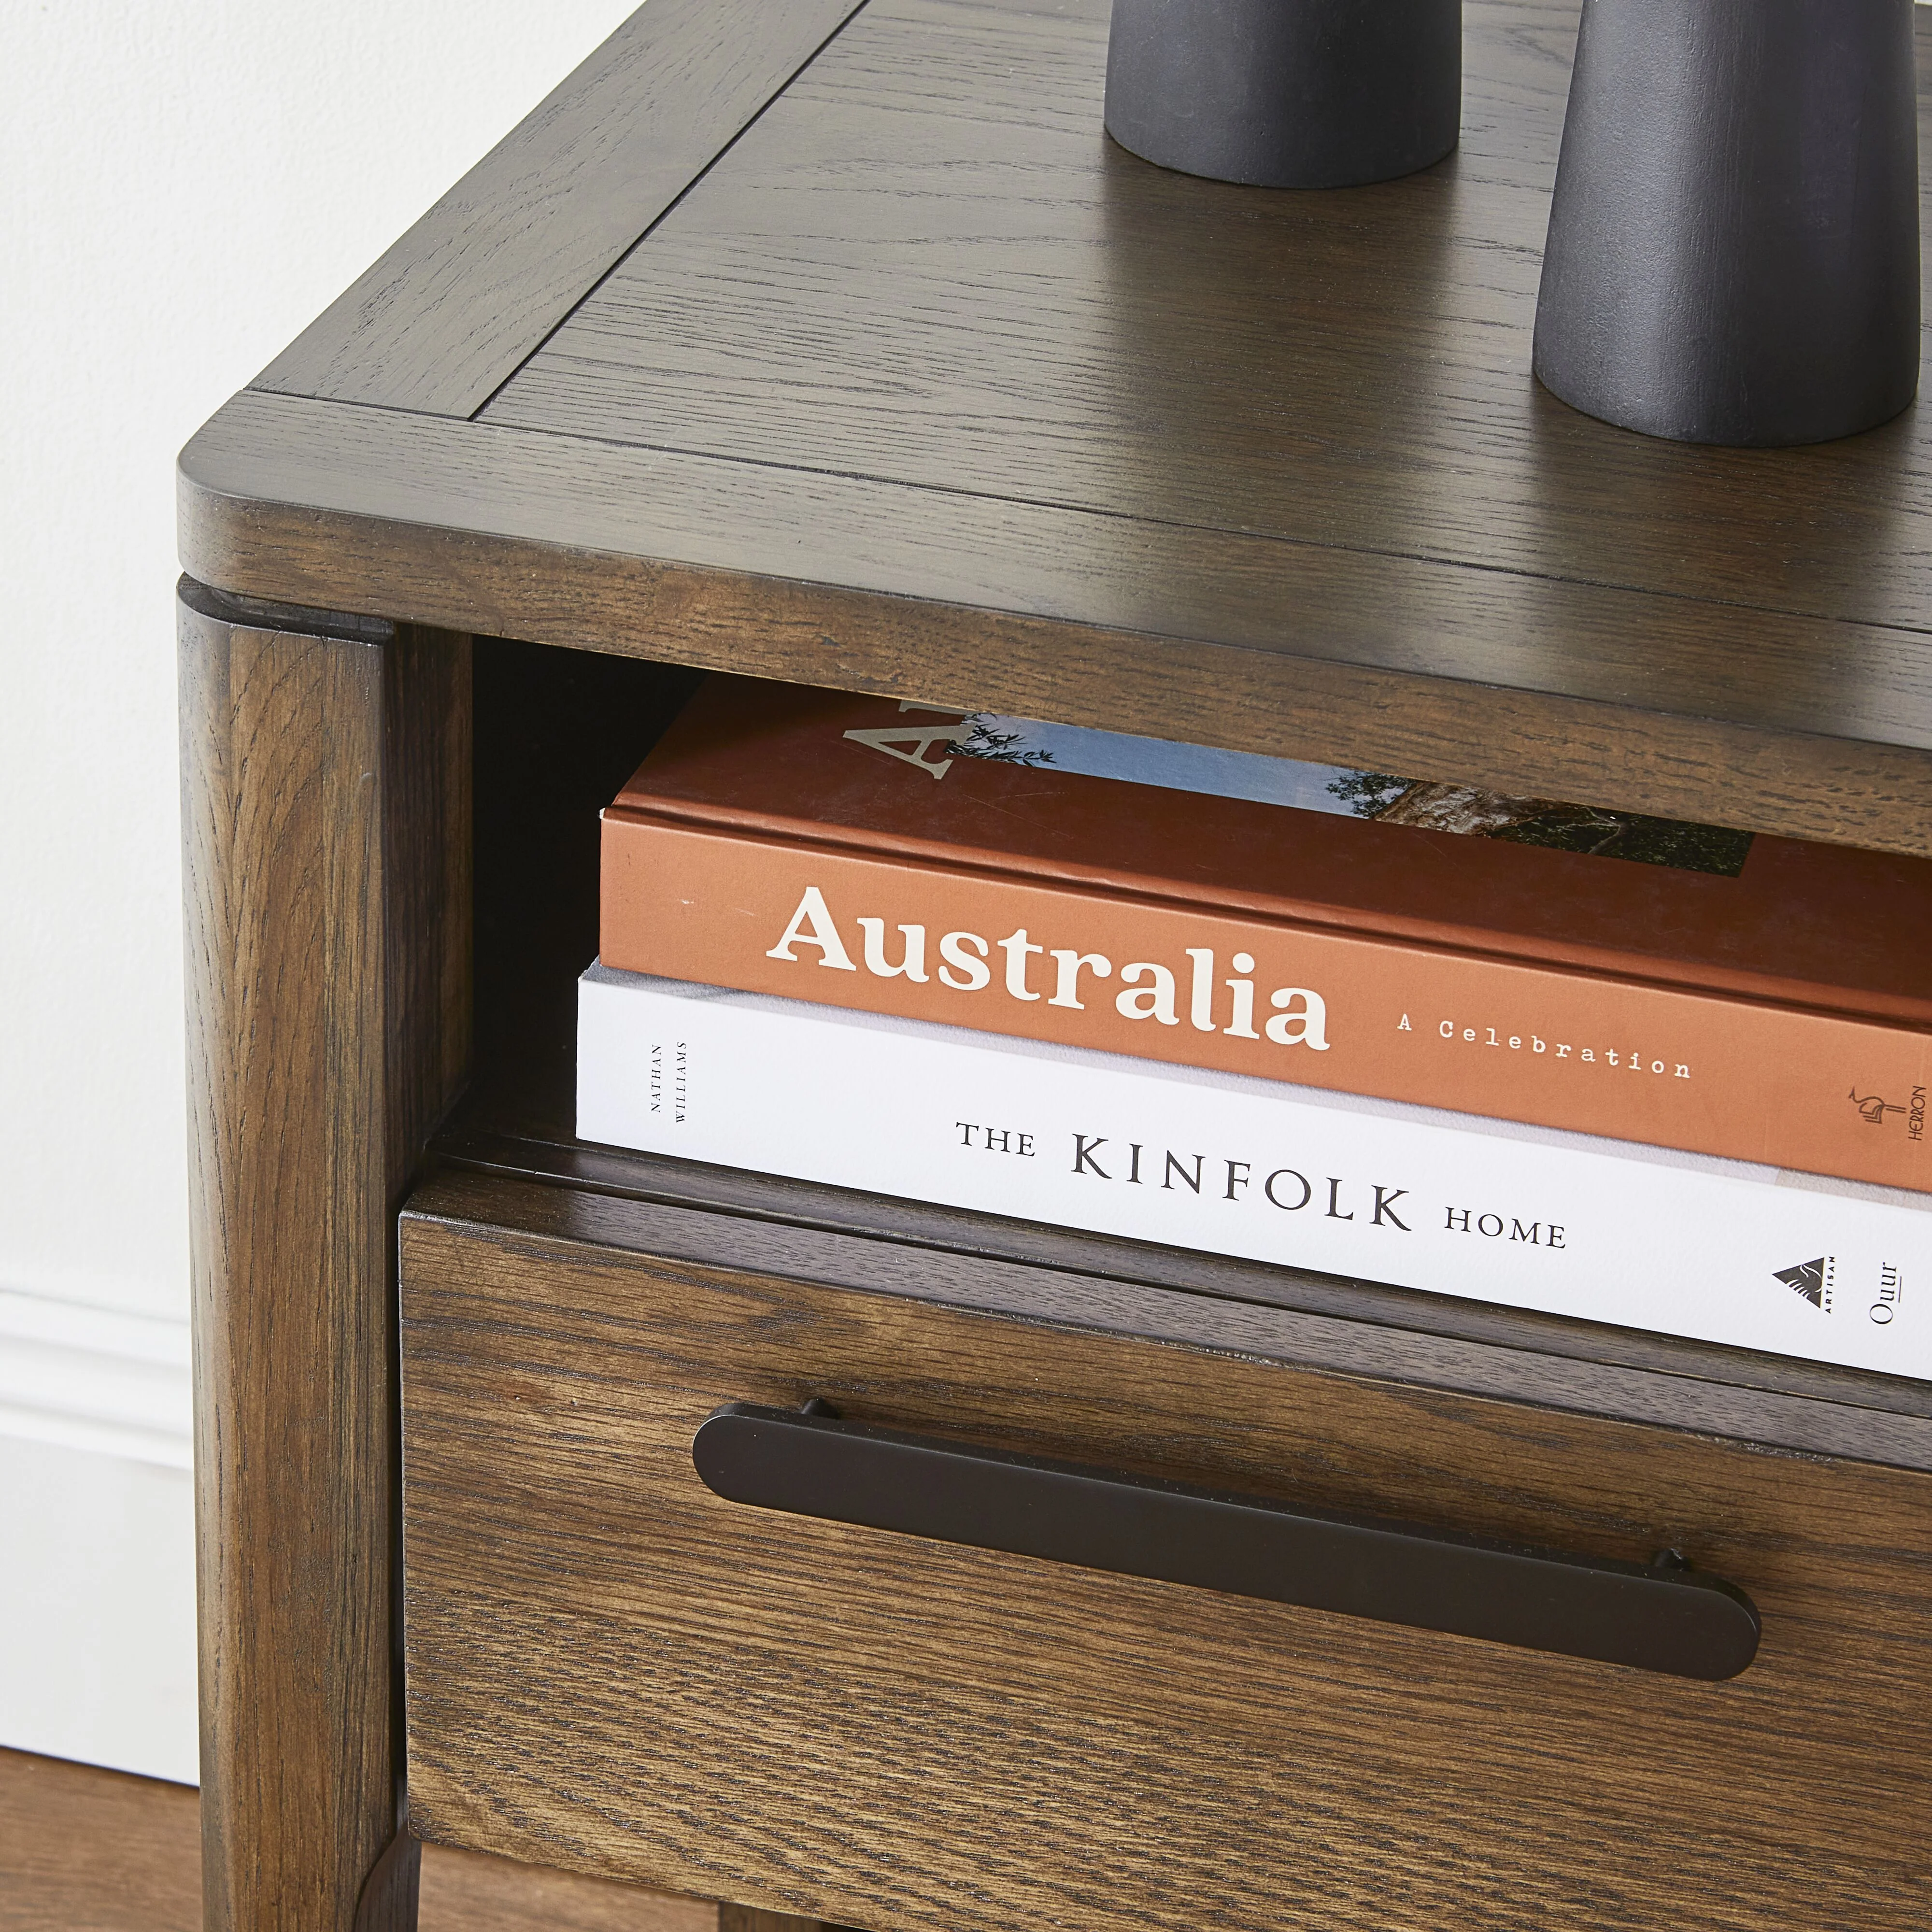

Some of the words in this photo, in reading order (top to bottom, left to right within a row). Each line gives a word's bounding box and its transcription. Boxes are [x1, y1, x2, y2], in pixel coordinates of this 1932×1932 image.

[766, 886, 1331, 1051] Australia
[651, 1044, 662, 1113] NATHAN
[1397, 1013, 1412, 1031] A
[1439, 1020, 1691, 1079] Celebration
[675, 1041, 687, 1123] WILLIAMS
[1907, 1085, 1927, 1141] HERRON
[956, 1122, 1036, 1157] THE
[1070, 1133, 1412, 1232] KINFOLK
[1443, 1206, 1566, 1250] HOME
[1824, 1256, 1836, 1315] ARTISAN
[1869, 1262, 1898, 1325] Ouur
